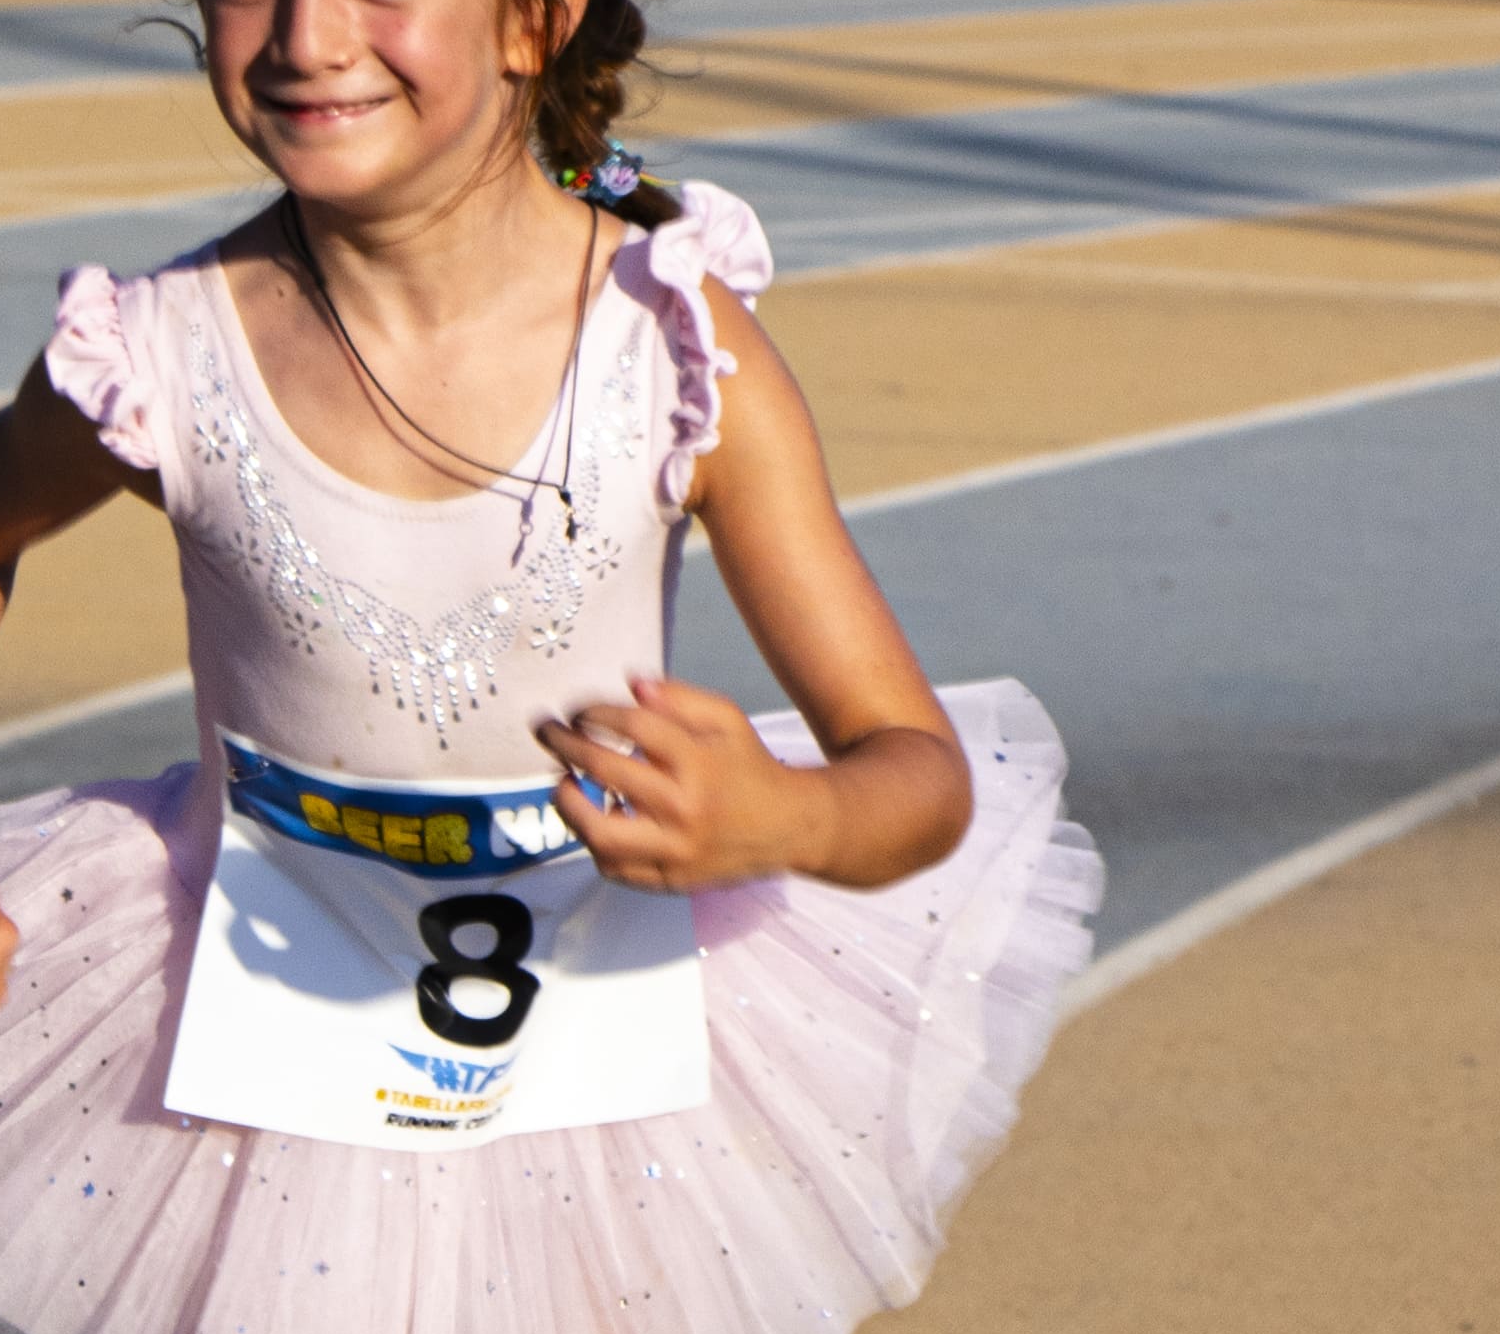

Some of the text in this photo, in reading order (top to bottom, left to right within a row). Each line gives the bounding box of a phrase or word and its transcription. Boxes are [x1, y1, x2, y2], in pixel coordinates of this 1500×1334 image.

[299, 792, 580, 866] BEER MI
[415, 893, 542, 1049] 8
